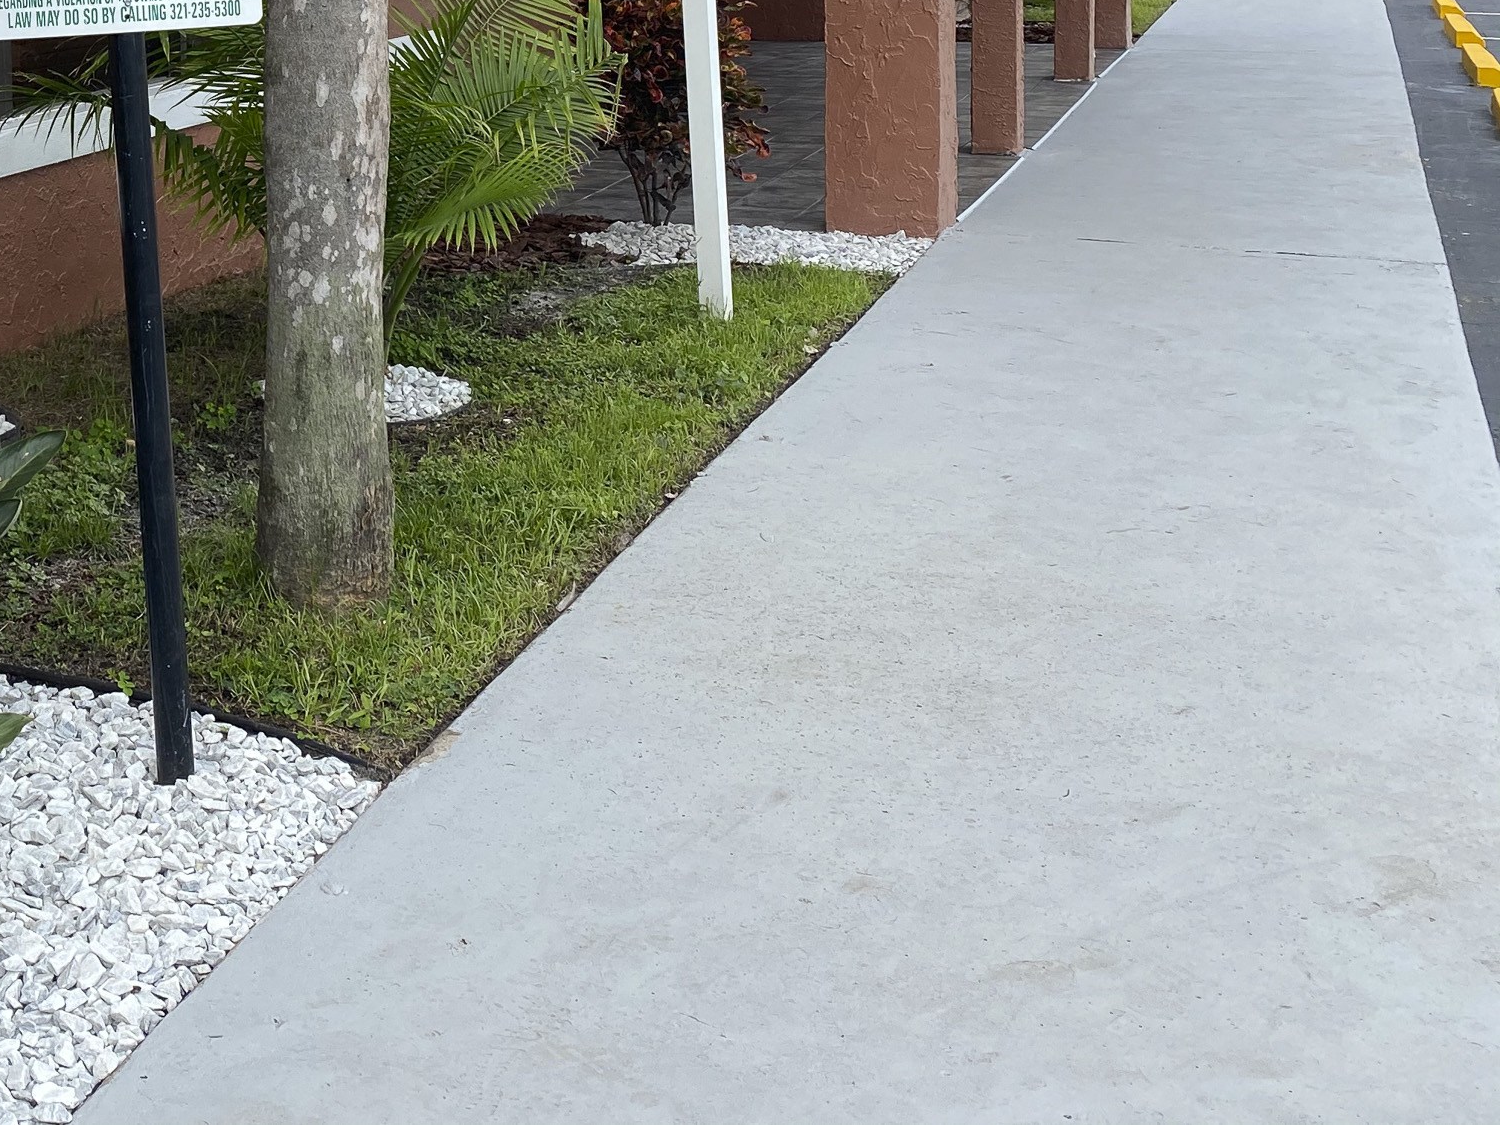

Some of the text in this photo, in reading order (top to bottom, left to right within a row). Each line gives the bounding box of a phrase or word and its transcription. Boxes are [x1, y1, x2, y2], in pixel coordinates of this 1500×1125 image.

[8, 0, 241, 28] LAW MAY DO SO BY CALLING 321-235-5300
